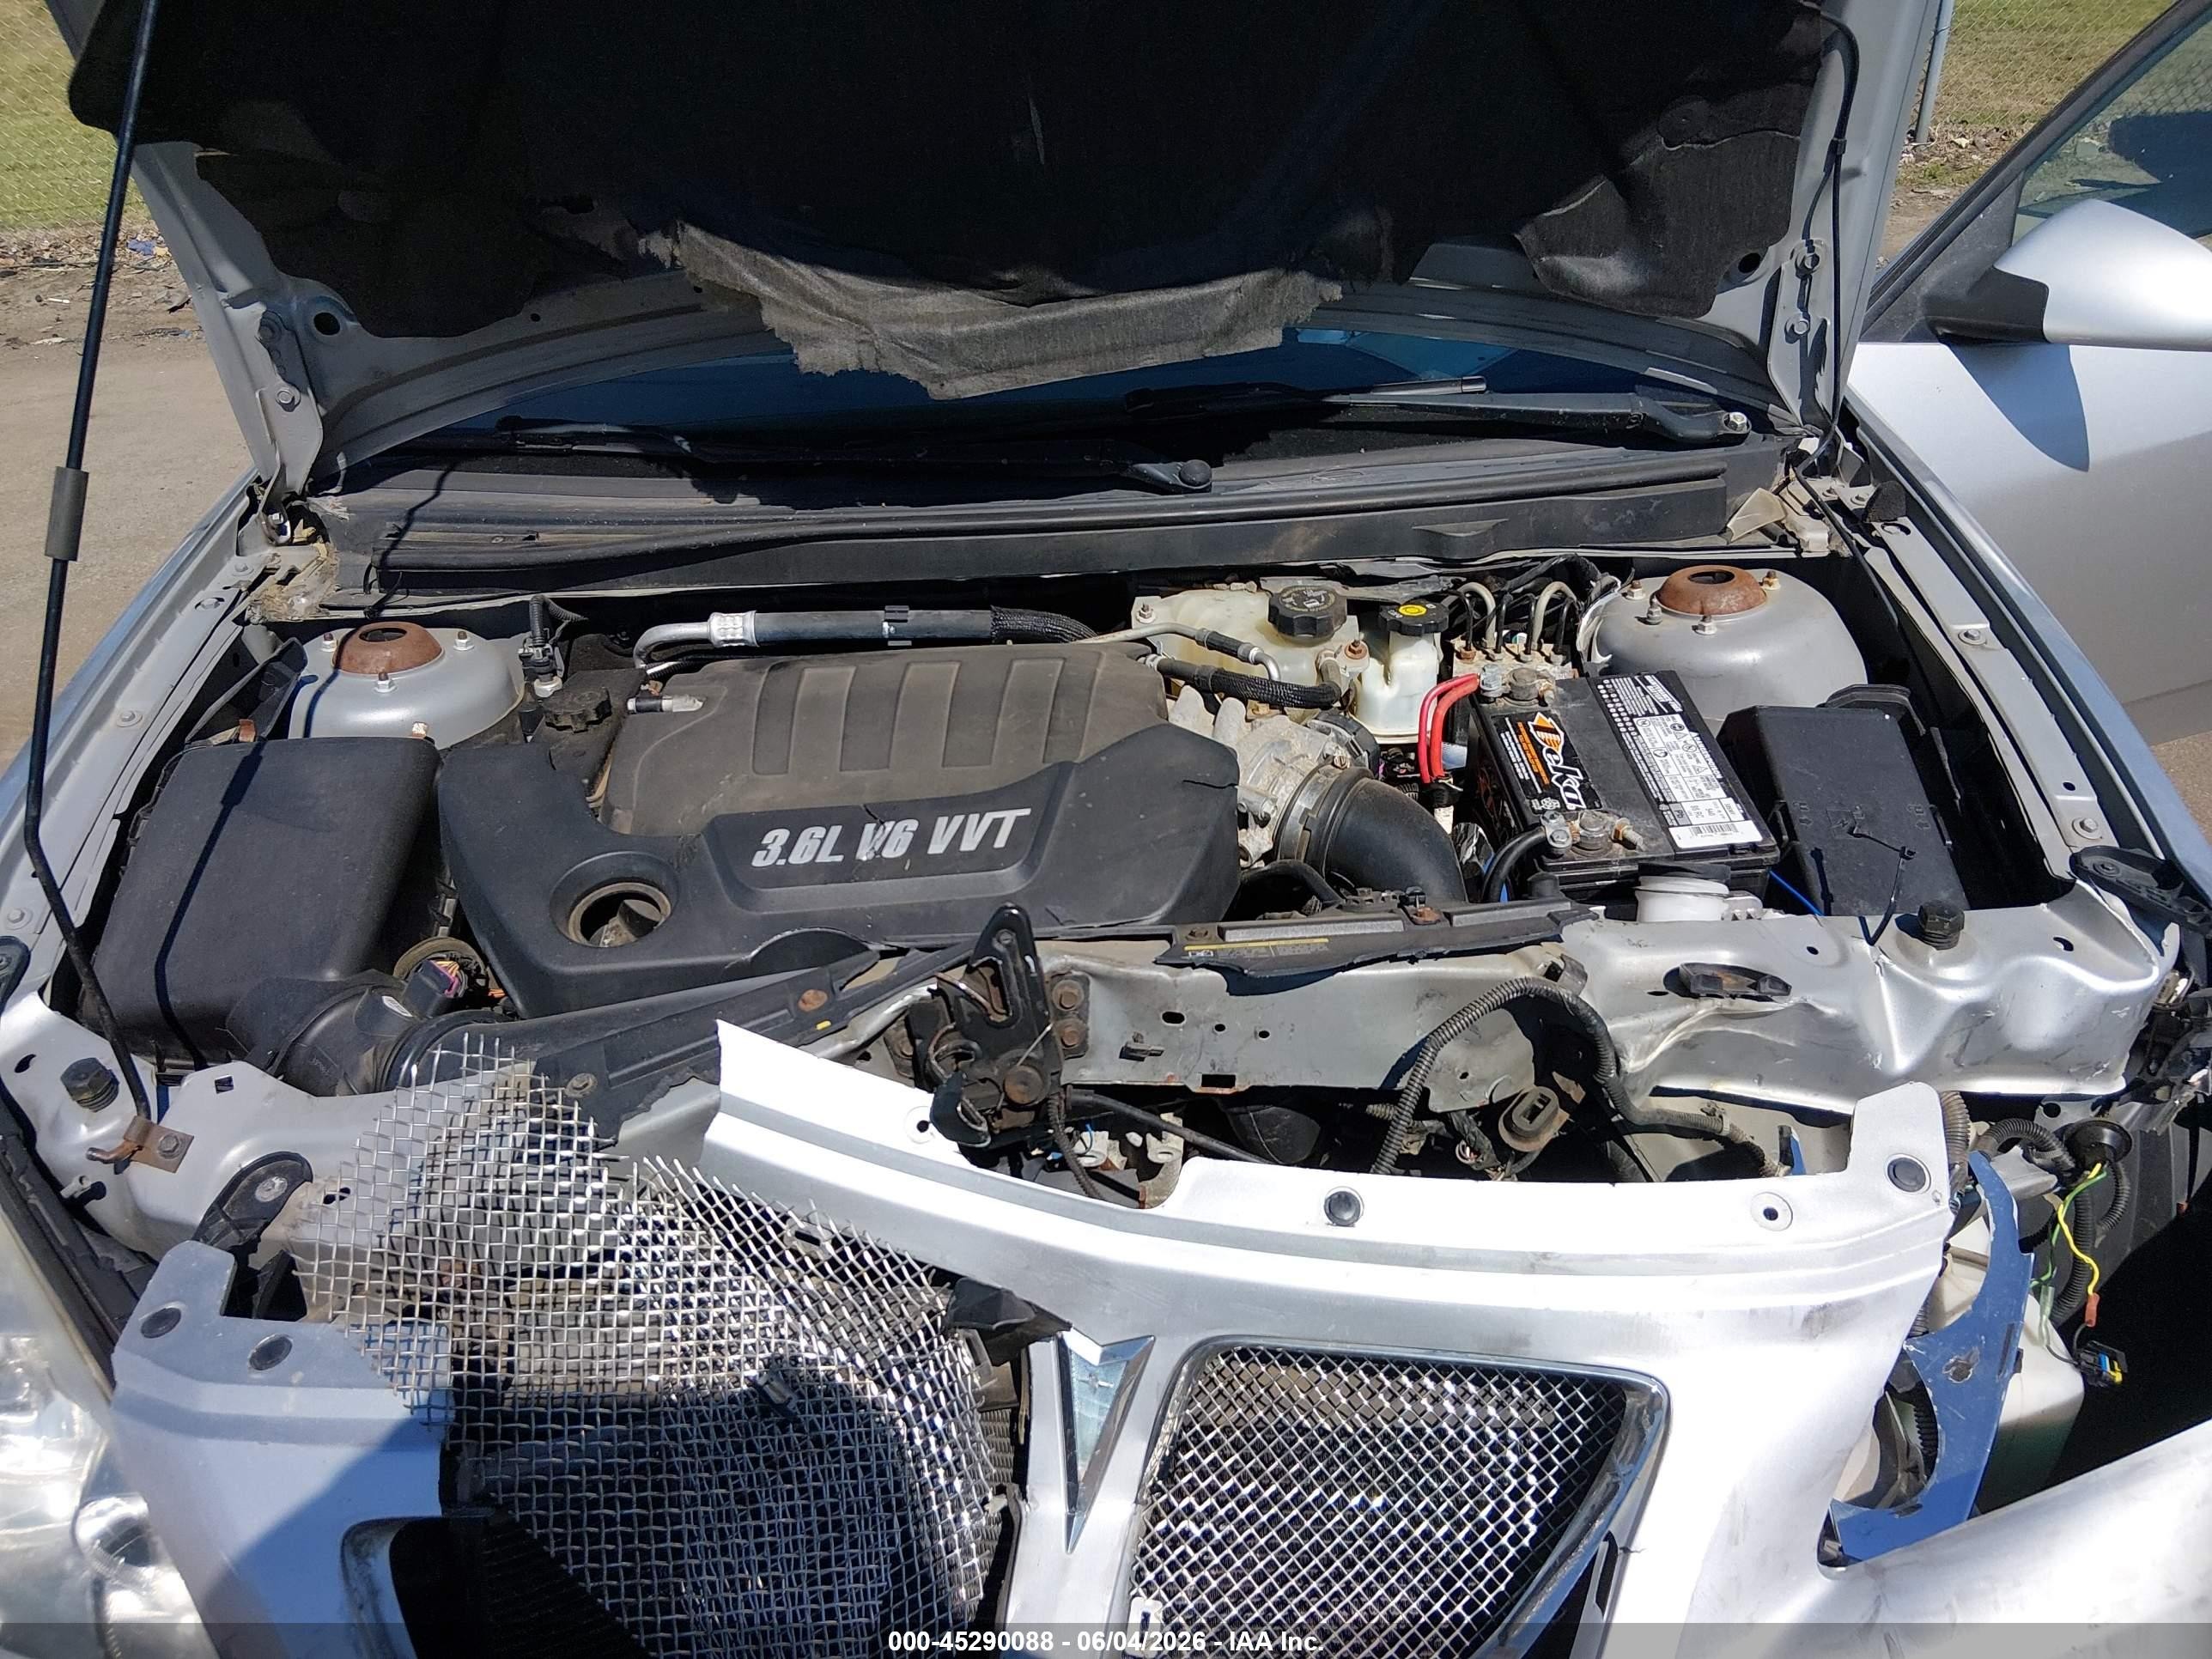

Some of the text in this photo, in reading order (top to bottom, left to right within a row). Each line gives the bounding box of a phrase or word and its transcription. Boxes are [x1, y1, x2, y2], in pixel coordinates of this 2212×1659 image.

[750, 807, 1032, 868] 3.6L V6 VVT
